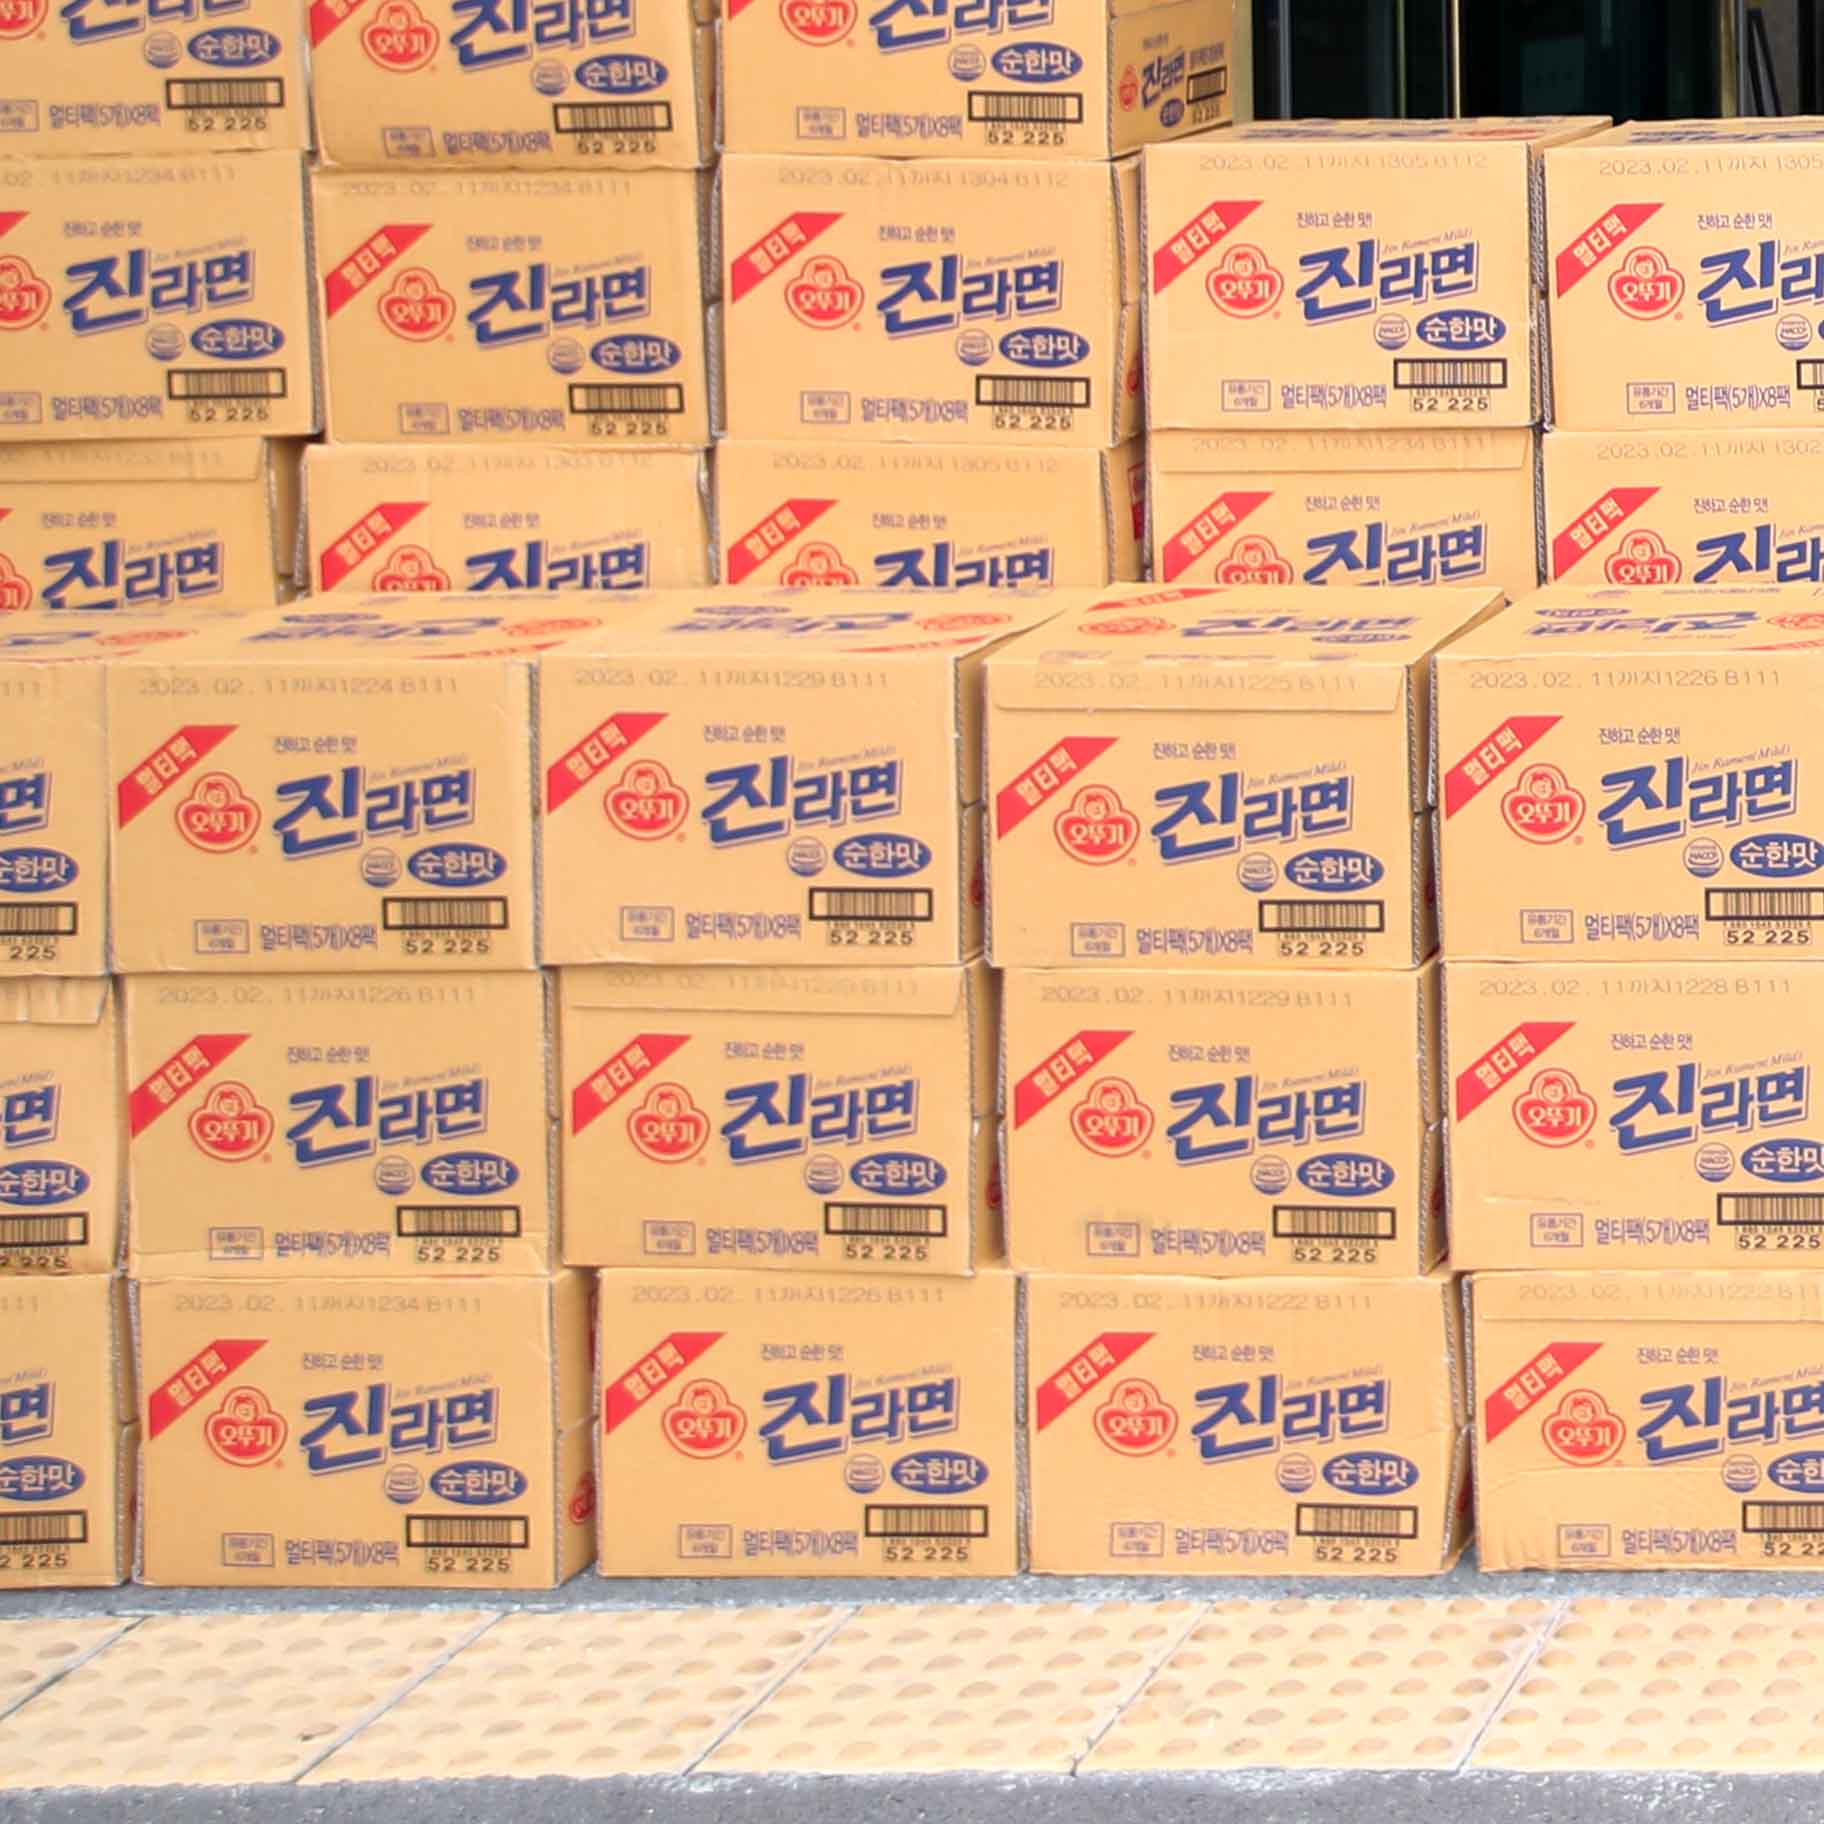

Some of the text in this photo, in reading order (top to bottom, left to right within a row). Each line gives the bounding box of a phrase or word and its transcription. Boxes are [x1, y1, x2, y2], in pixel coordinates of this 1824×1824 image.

[793, 6, 844, 28] 오뚜기
[999, 48, 1073, 76] 순한맛
[466, 260, 652, 352] 진라면
[1622, 283, 1672, 303] 오뚜기
[598, 340, 672, 367] 순한맛
[272, 764, 476, 862] 진라면
[1516, 802, 1571, 825] 오뚜기
[1597, 754, 1798, 853] 진라면
[416, 850, 497, 879] 순한맛
[1738, 841, 1818, 870] 순한맛
[1609, 1060, 1810, 1158] 진라면
[219, 1426, 273, 1449] 오뚜기
[299, 1380, 498, 1480] 진라면
[439, 1468, 518, 1498] 순한맛
